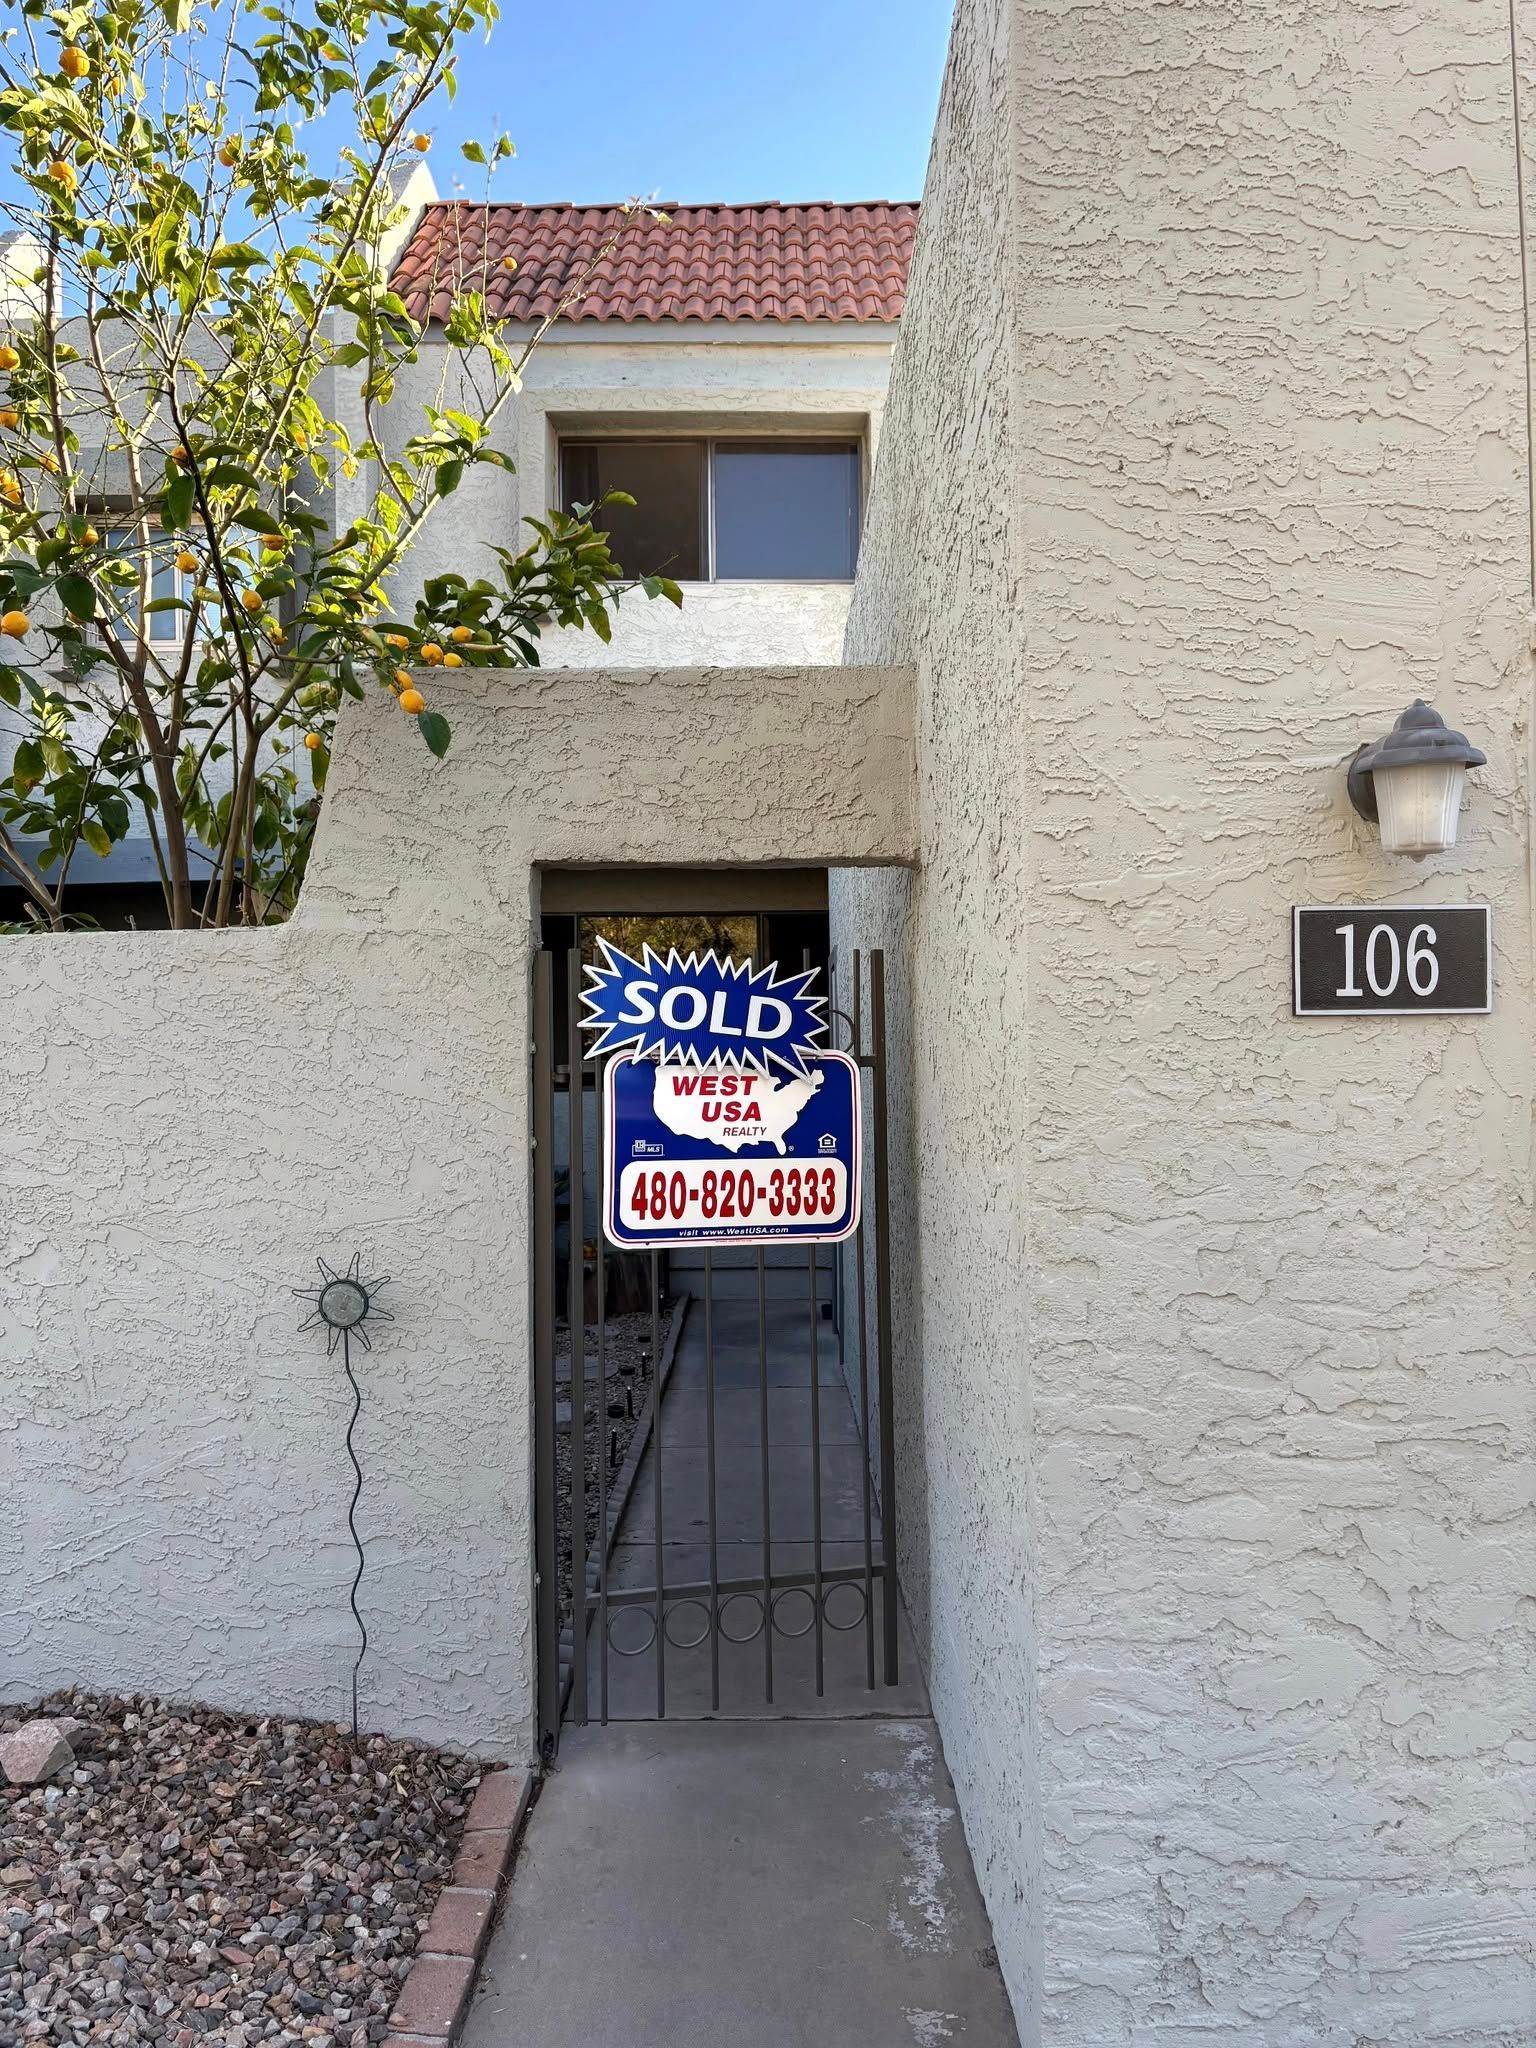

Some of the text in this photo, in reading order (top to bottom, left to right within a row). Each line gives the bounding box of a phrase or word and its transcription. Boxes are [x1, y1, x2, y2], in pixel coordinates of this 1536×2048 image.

[1335, 923, 1439, 997] 106
[618, 980, 793, 1039] SOLD
[672, 1075, 758, 1096] WEST
[701, 1101, 762, 1122] USA
[722, 1126, 767, 1136] REALTY
[631, 1167, 836, 1220] 480-820-3333
[702, 1226, 789, 1236] www.WestUSA.com
